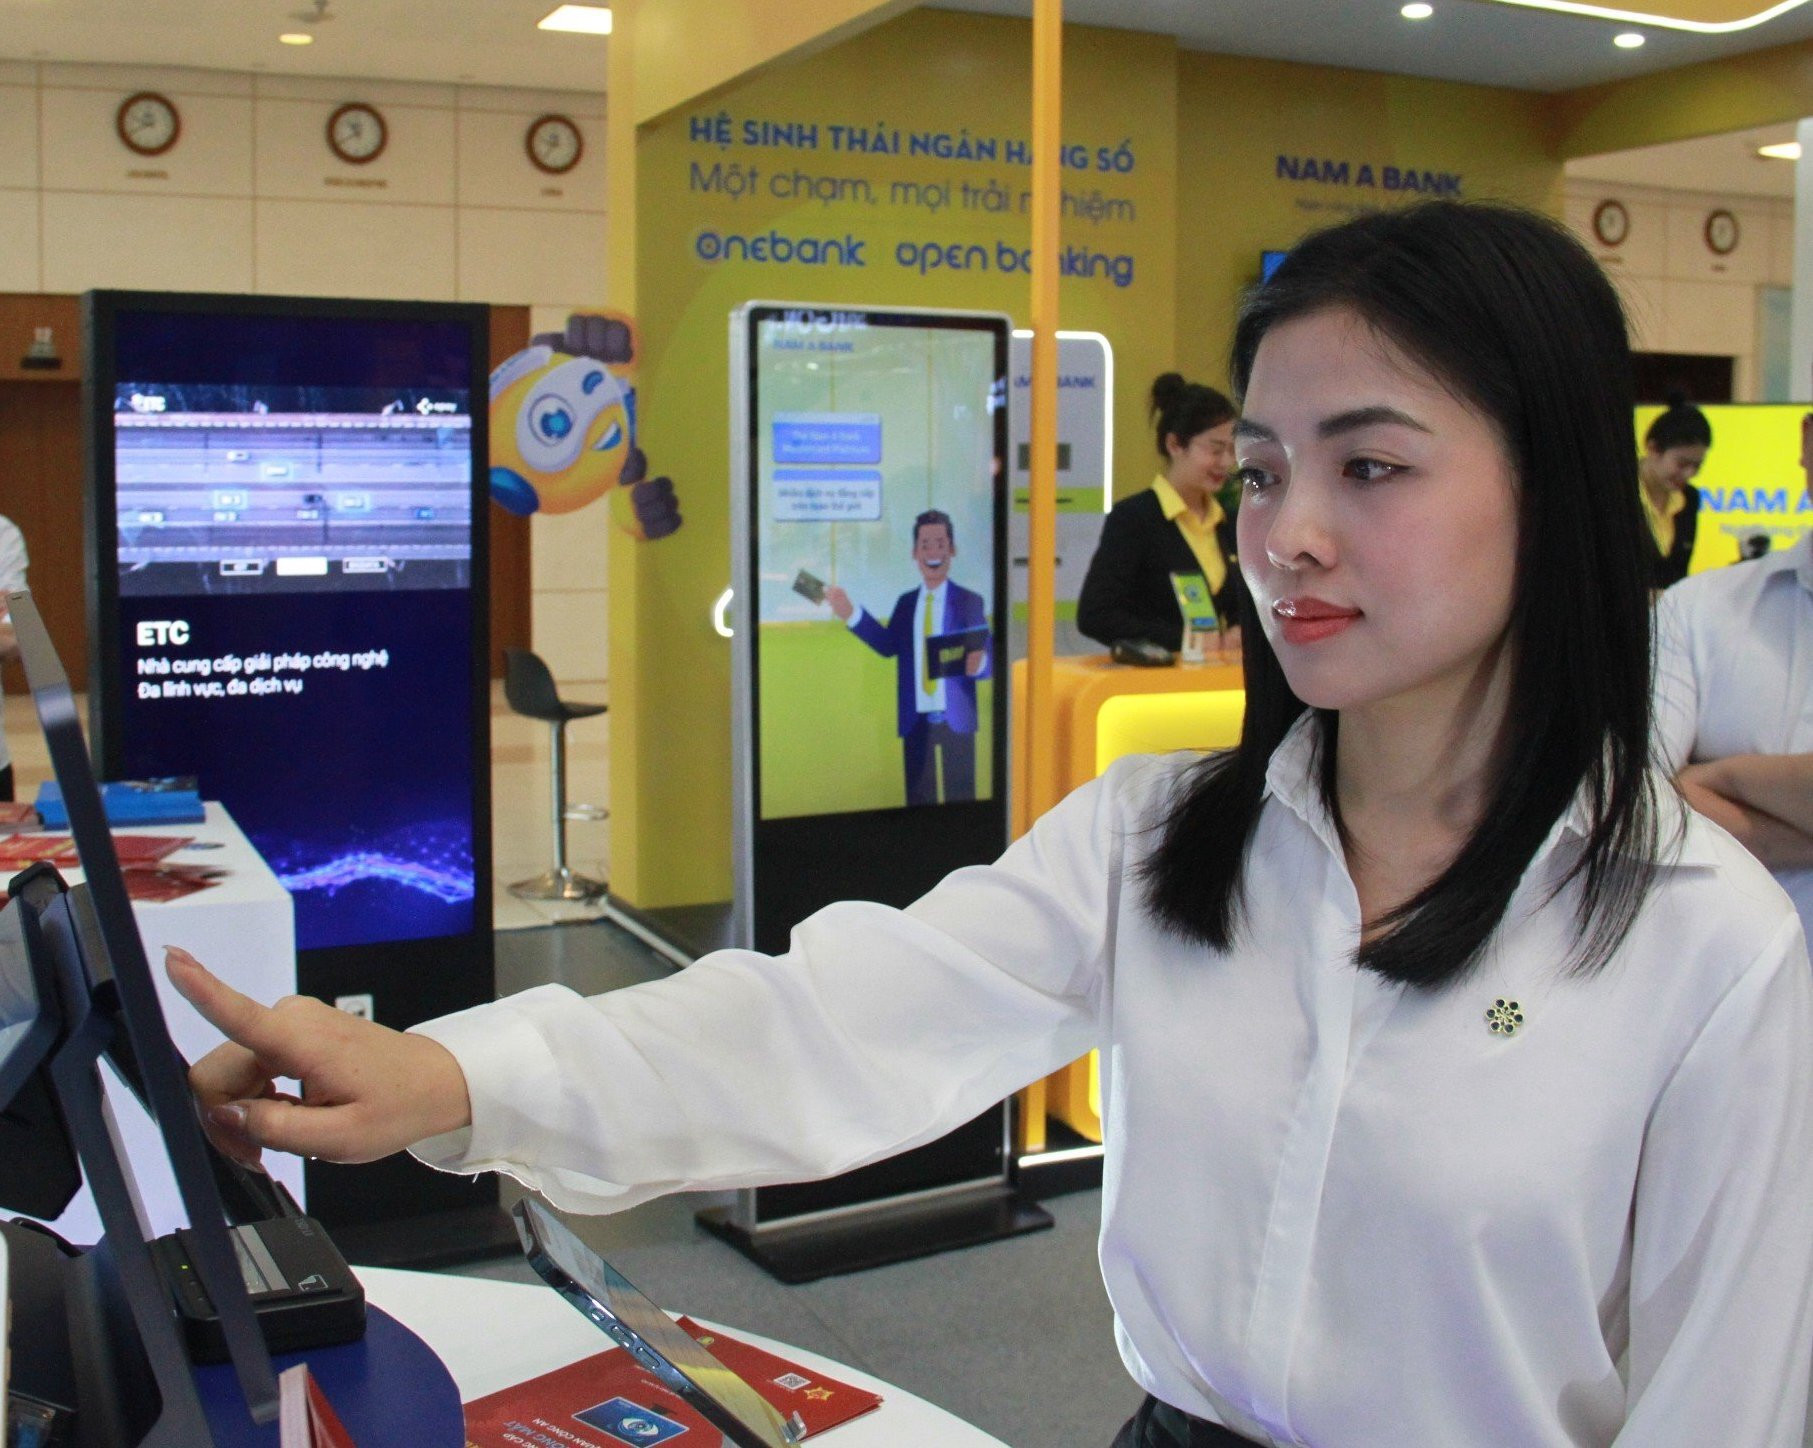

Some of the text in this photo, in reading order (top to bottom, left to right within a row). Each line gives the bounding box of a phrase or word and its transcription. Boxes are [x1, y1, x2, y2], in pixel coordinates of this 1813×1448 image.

[690, 111, 732, 151] HỆ
[742, 119, 818, 150] SINH
[827, 121, 900, 155] THÁI
[1004, 139, 1089, 171] HG
[1096, 136, 1135, 173] SỐ
[1276, 154, 1462, 197] NAM A BANK
[689, 161, 758, 199] Một
[891, 178, 951, 213] mọi
[1019, 187, 1136, 225] nhiệm
[895, 241, 989, 276] open
[996, 240, 1134, 287] bking
[1698, 487, 1788, 513] NAM
[137, 620, 190, 646] ETC
[137, 657, 171, 675] Nhà
[172, 658, 212, 677] cung
[212, 654, 243, 674] cấp
[272, 651, 312, 673] pháp
[312, 650, 350, 671] công
[351, 648, 390, 669] nghệ
[137, 681, 162, 699] Đa
[249, 676, 283, 696] dịch
[283, 678, 304, 695] vụ
[531, 1417, 550, 1427] AN
